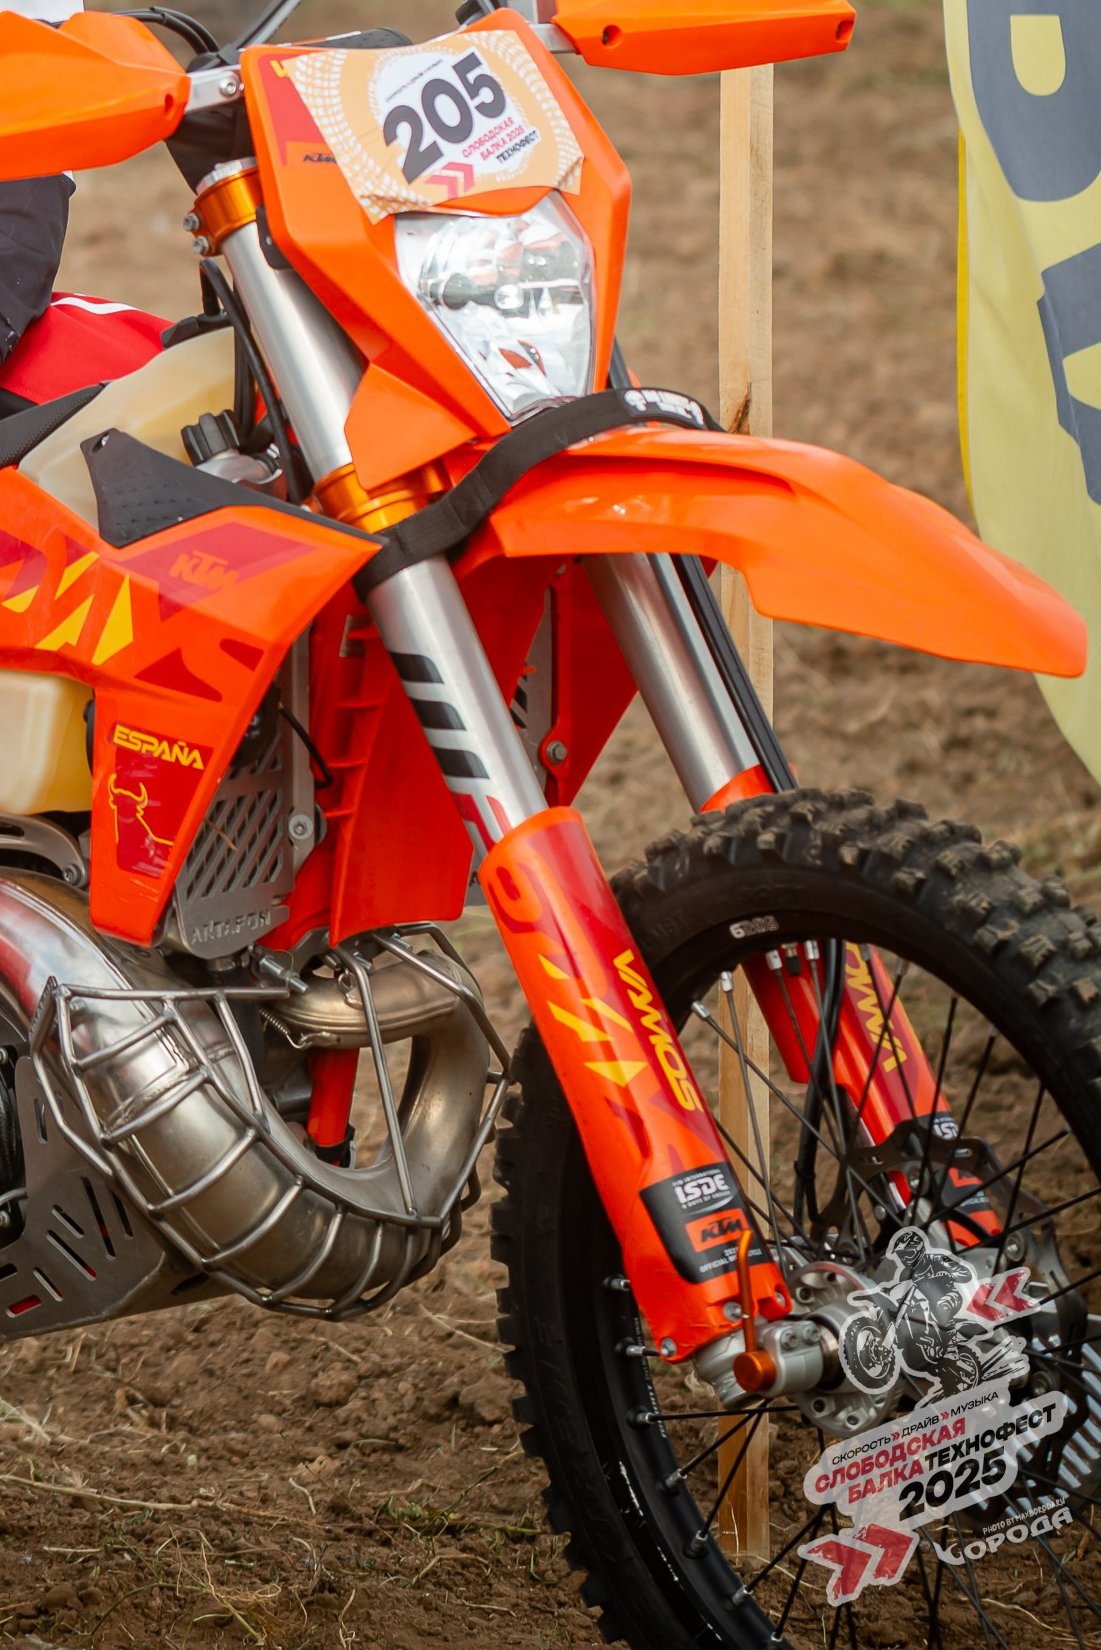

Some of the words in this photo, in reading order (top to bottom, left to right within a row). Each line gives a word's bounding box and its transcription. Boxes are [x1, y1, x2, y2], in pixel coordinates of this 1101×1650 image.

[383, 52, 506, 185] 205
[169, 550, 240, 592] KTM
[113, 722, 205, 771] ESPAÑA
[612, 948, 706, 1114] VAMOS
[674, 1172, 731, 1205] ISDE
[701, 1217, 744, 1243] KTM
